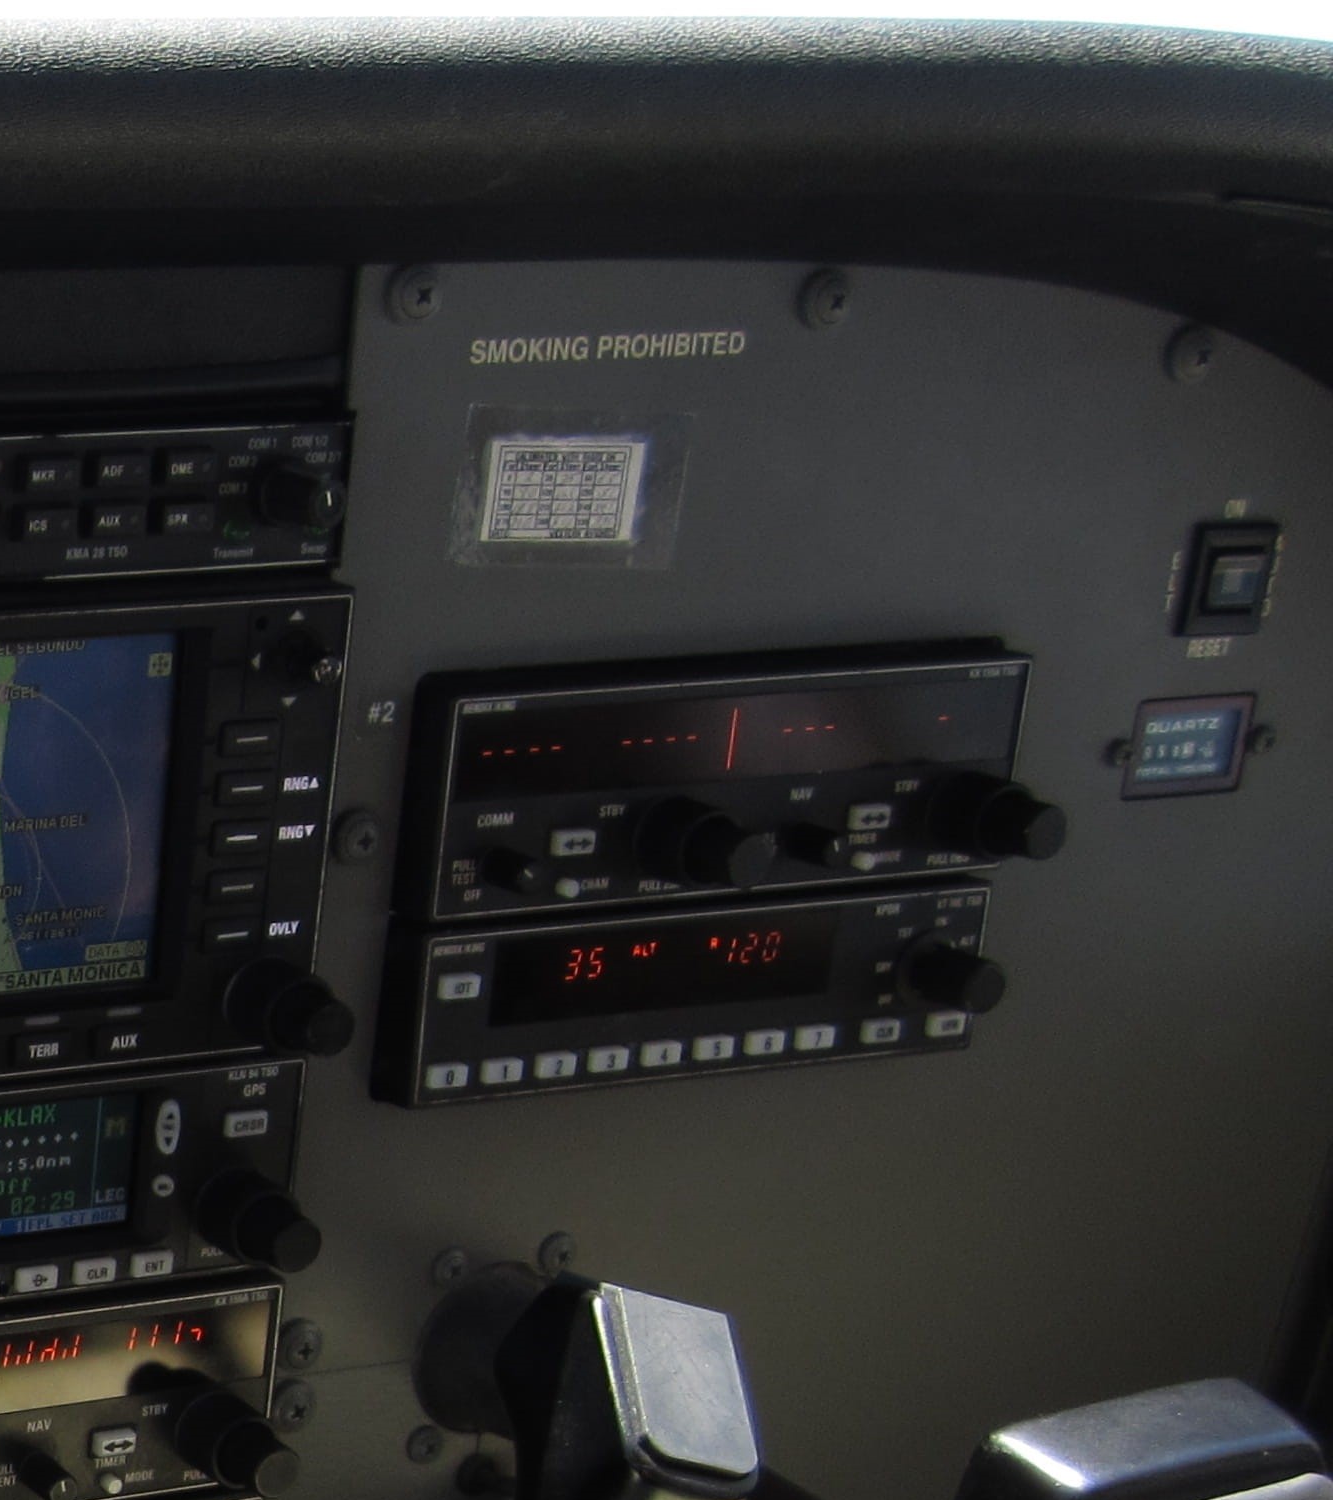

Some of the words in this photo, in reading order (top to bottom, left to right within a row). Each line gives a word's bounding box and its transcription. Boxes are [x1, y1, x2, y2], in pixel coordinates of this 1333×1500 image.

[469, 336, 589, 365] SMOKING
[597, 331, 745, 359] PROHIBITED
[367, 701, 396, 724] #2
[477, 811, 514, 829] COMM
[269, 920, 300, 937] OVLY
[67, 958, 144, 984] MONICA
[111, 1033, 138, 1050] AUX
[4, 1103, 56, 1128] KLAX
[27, 1418, 52, 1434] NAV
